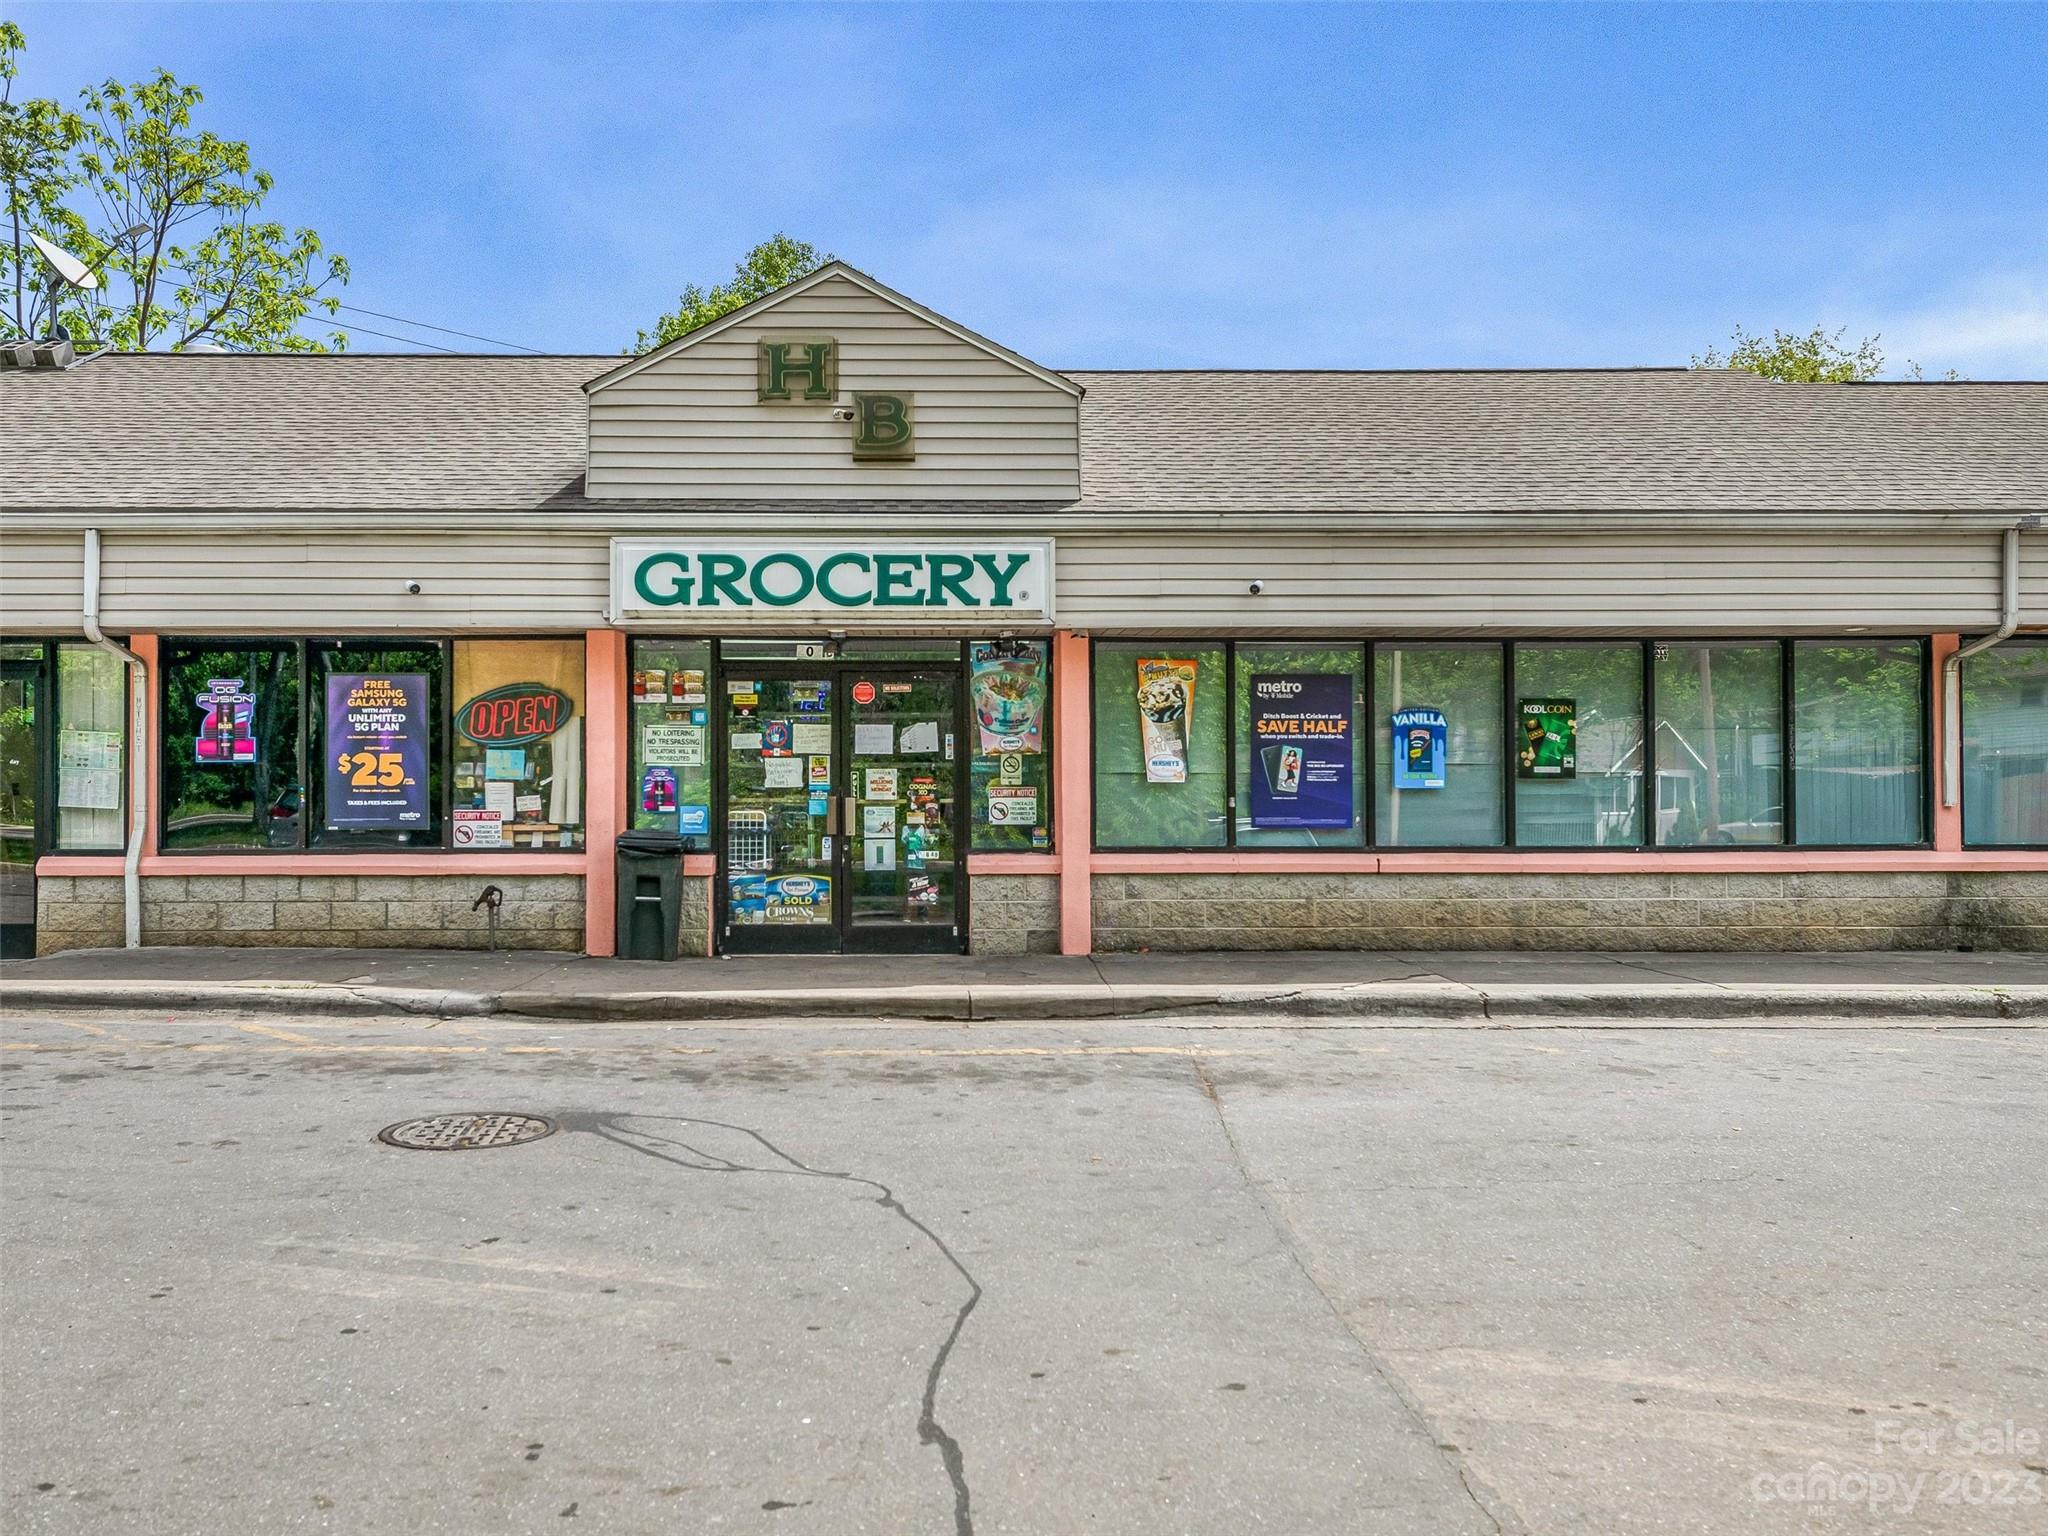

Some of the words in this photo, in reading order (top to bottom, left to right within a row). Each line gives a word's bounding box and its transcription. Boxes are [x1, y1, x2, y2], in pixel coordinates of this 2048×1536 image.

[763, 343, 831, 399] H
[856, 394, 911, 446] B
[635, 552, 1030, 607] GROCERY
[364, 680, 391, 689] FREE
[1257, 680, 1302, 693] metro
[215, 686, 236, 694] OG
[351, 689, 404, 698] SAMSUNG
[199, 695, 253, 703] FUSION
[347, 698, 392, 707] GALAXY
[393, 698, 407, 707] 5G
[348, 714, 406, 723] UNLIMITED
[469, 694, 558, 738] OPEN
[1392, 712, 1447, 727] VANILLA
[355, 723, 369, 731] 5G
[371, 723, 400, 731] PLAN
[1257, 720, 1300, 733] SAVE
[1303, 720, 1348, 733] HALF
[338, 752, 405, 787] $25
[990, 789, 1016, 797] SECURITY
[1017, 789, 1035, 797] NOTICE
[455, 812, 481, 820] SECURITY
[482, 812, 502, 820] NOTICE
[784, 896, 813, 905] SOLD
[766, 906, 814, 918] CROWNS
